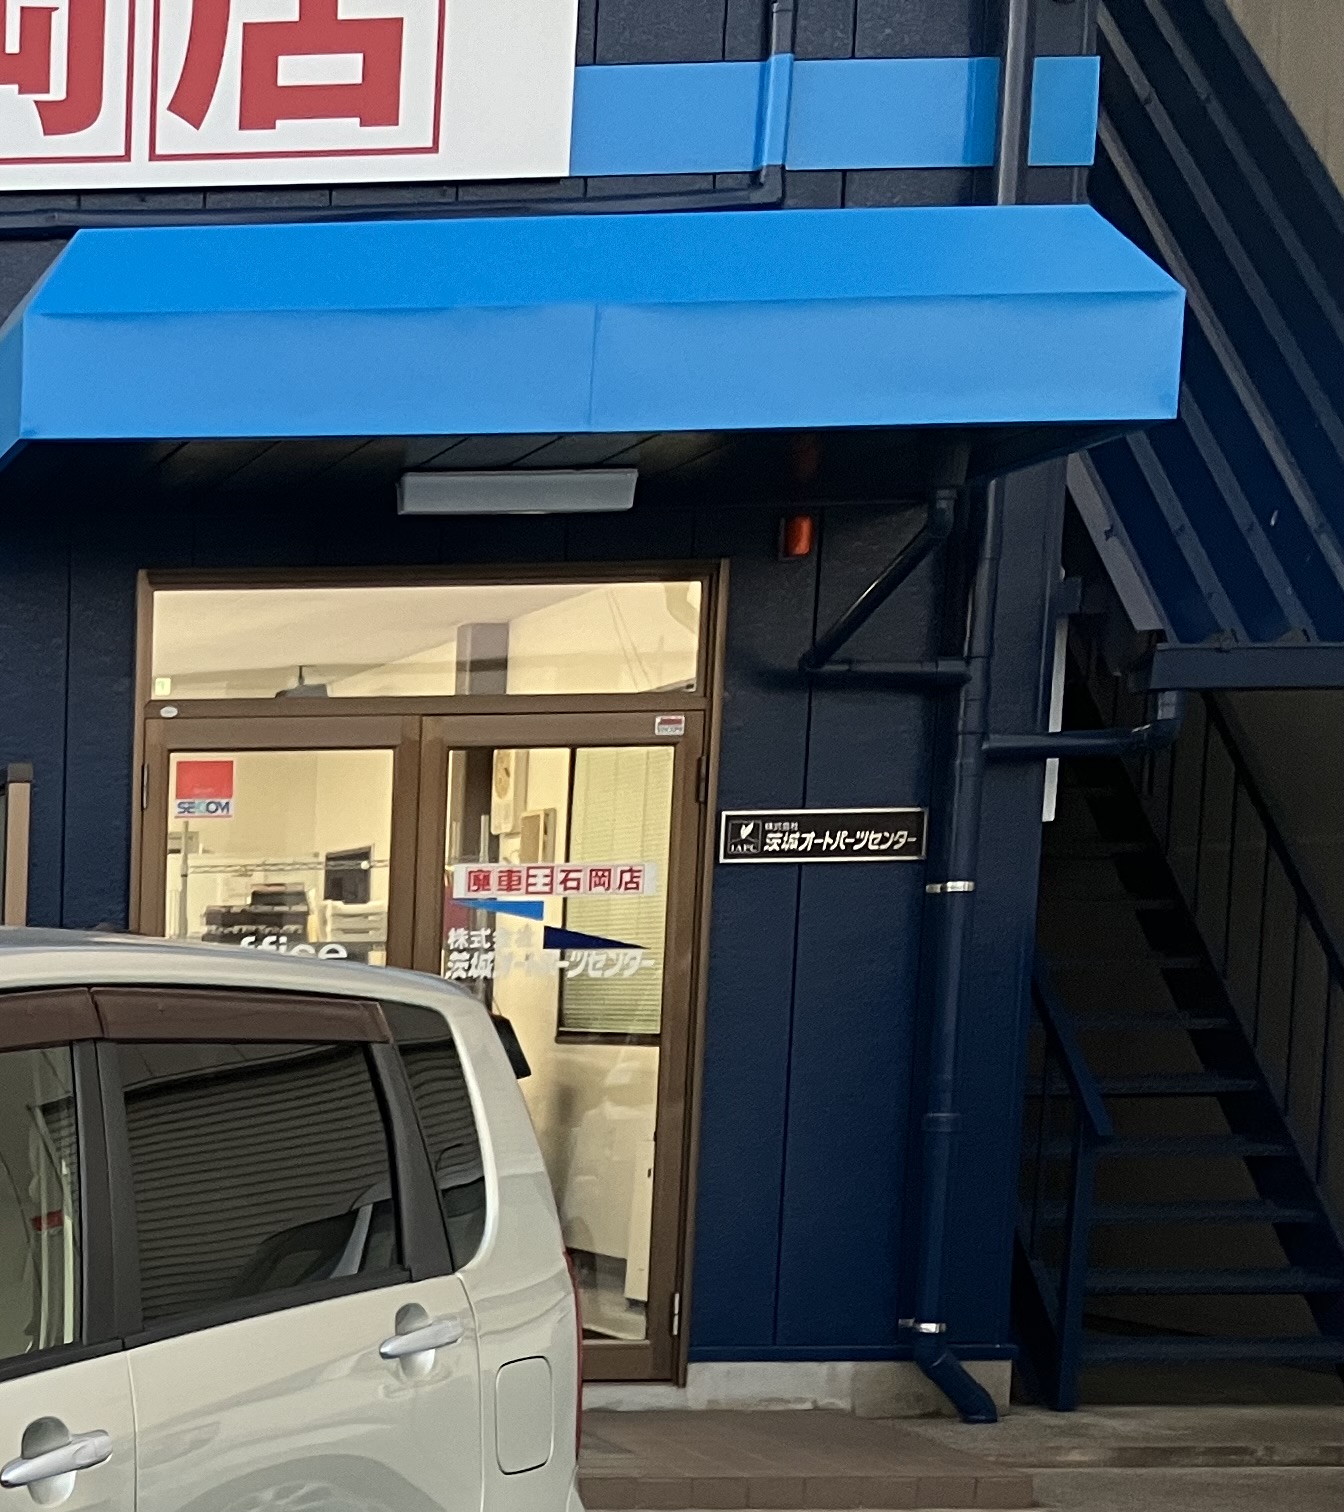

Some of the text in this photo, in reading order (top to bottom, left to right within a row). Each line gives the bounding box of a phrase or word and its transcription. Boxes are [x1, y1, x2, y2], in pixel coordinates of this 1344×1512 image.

[177, 801, 230, 814] SECOM
[763, 830, 917, 852] 茨城オートパーツセンター
[467, 866, 643, 895] 廃車王石岡店
